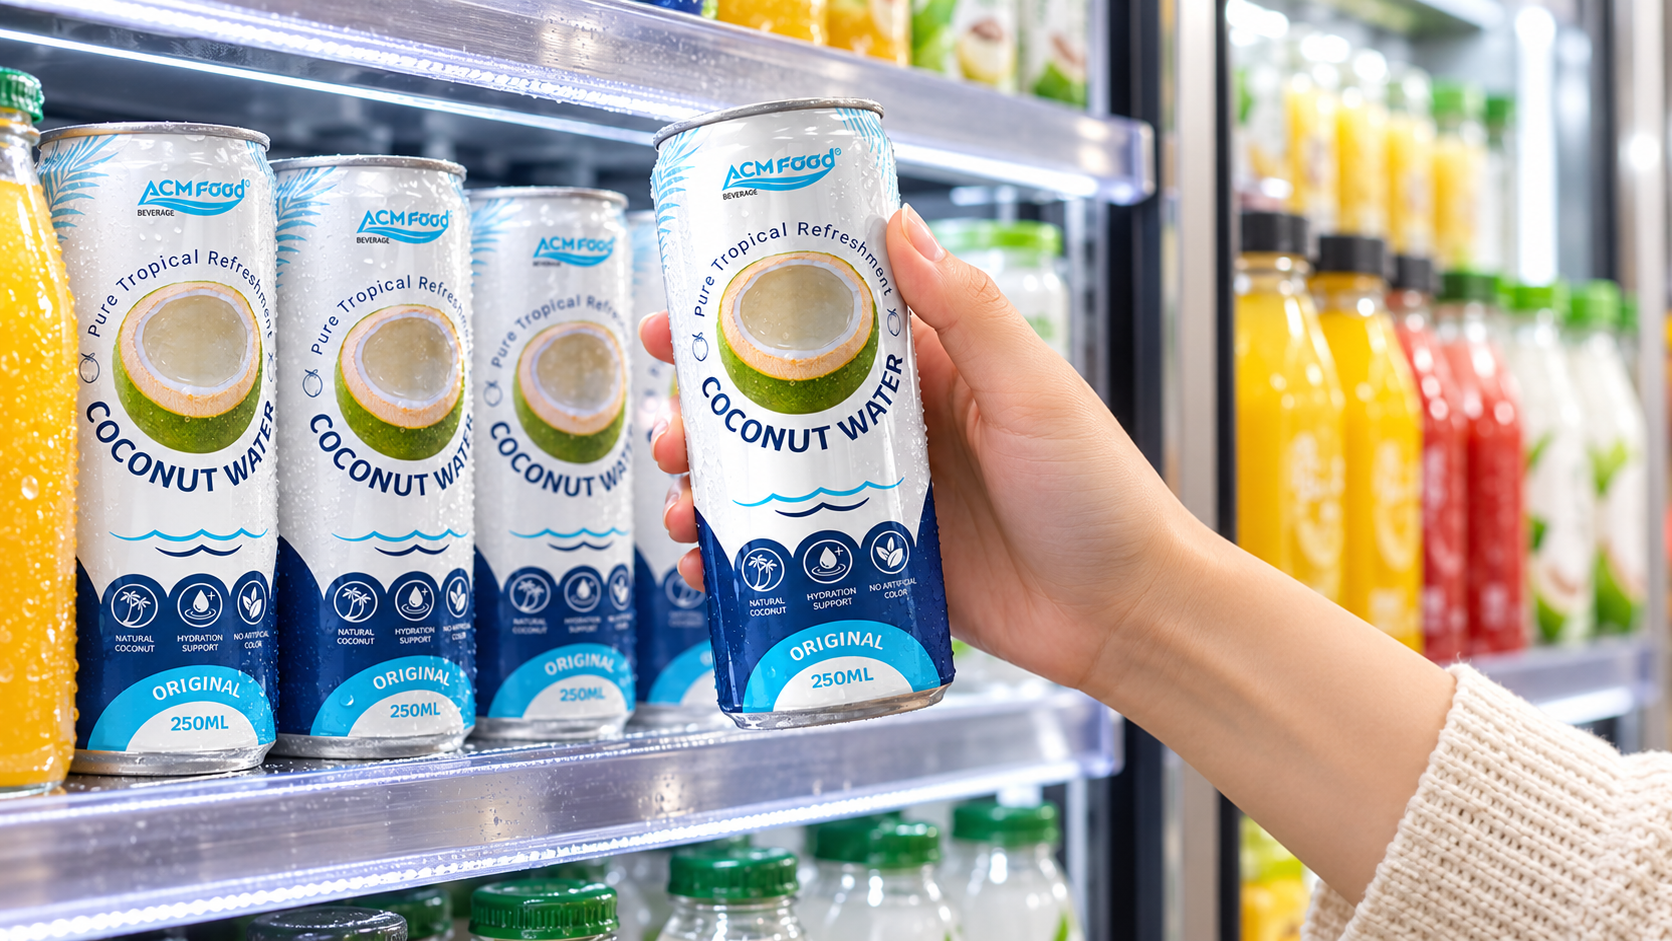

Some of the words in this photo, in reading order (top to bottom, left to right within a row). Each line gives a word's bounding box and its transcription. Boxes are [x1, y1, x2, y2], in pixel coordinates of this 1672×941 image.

[722, 189, 758, 200] BEVERAGE
[137, 209, 175, 217] BEVERAGE
[694, 275, 715, 317] Pure
[711, 222, 788, 271] Tropical
[797, 222, 892, 297] Refreshment
[88, 294, 118, 338] Pure
[115, 249, 198, 293] Tropical
[207, 250, 273, 339] Refreshment
[311, 315, 340, 355] Pure
[336, 274, 411, 314] Tropical
[491, 330, 517, 369] Pure
[514, 294, 581, 331] Tropical
[702, 376, 831, 453] COCONUT
[837, 354, 903, 441] WATER
[86, 401, 218, 493] COCONUT
[223, 400, 274, 487] WATER
[310, 413, 429, 497] COCONUT
[433, 413, 474, 491] WATER
[490, 422, 596, 497] COCONUT
[806, 587, 857, 601] HYDRATION
[869, 583, 881, 592] NO
[884, 588, 908, 599] COLOR
[749, 597, 786, 607] NATURAL
[813, 597, 853, 610] SUPPORT
[749, 606, 787, 617] COCONUT
[233, 632, 244, 640] NO
[338, 628, 374, 636] NATURAL
[395, 626, 435, 635] HYDRATION
[115, 634, 154, 643] NATURAL
[177, 634, 223, 642] HYDRATION
[337, 637, 375, 645] COCONUT
[399, 636, 431, 644] SUPPORT
[114, 644, 155, 653] COCONUT
[182, 643, 219, 652] SUPPORT
[789, 631, 884, 661] ORIGINAL
[544, 653, 615, 676] ORIGINAL
[373, 666, 450, 690] ORIGINAL
[811, 667, 874, 689] 250ML
[152, 676, 240, 701] ORIGINAL
[560, 687, 606, 702] 250ML
[390, 702, 441, 718] 250ML
[170, 715, 229, 731] 250ML
